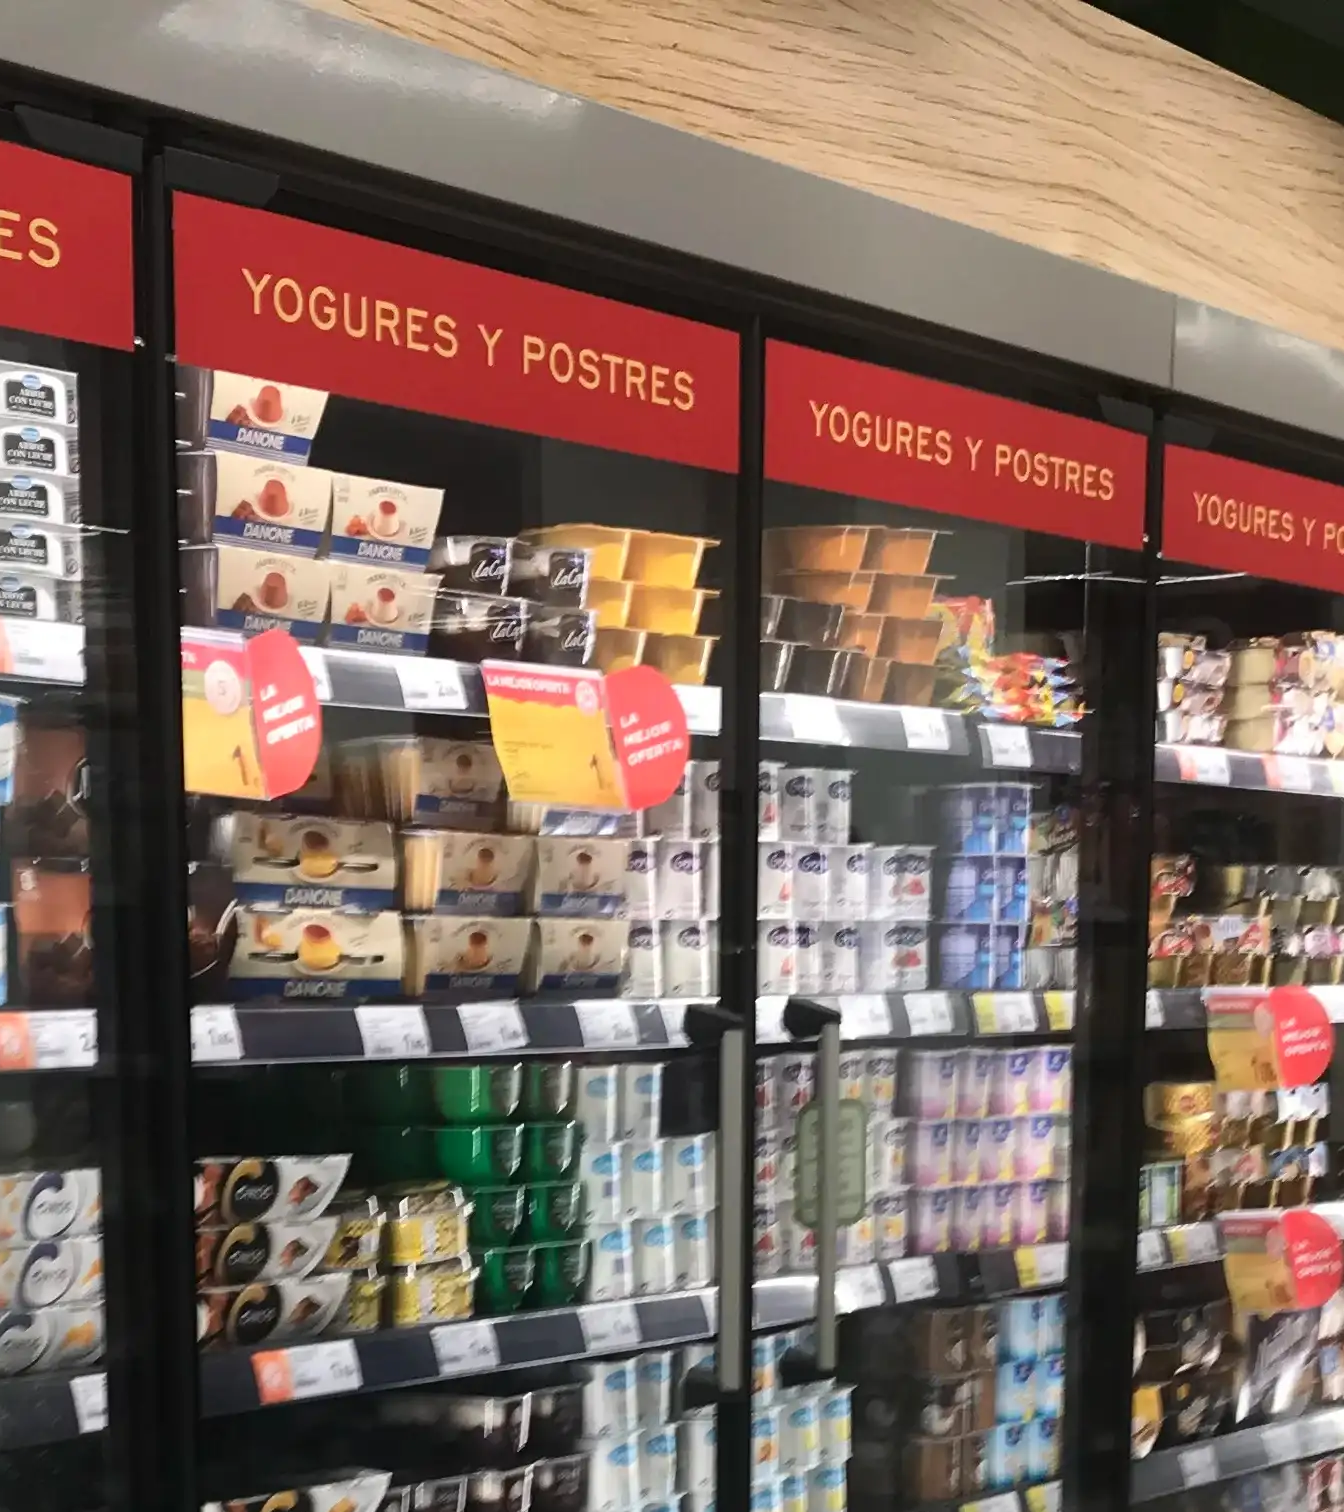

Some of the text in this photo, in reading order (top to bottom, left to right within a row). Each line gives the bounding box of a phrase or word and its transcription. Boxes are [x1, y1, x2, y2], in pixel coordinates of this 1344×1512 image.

[242, 267, 695, 412] YOGURES Y POSTRES
[236, 427, 285, 451] DANONE
[809, 399, 1115, 501] YOGURES Y POSTRES
[1193, 491, 1294, 542] YOGURES
[1303, 518, 1317, 547] Y
[243, 523, 294, 544] DANONE
[358, 542, 404, 561] DANONE
[356, 629, 403, 647] DANONE
[620, 711, 640, 728] LA
[623, 720, 672, 747] MEJOR
[627, 738, 684, 767] OFERTA
[284, 887, 346, 907] DANONE
[284, 980, 347, 999] DANONE
